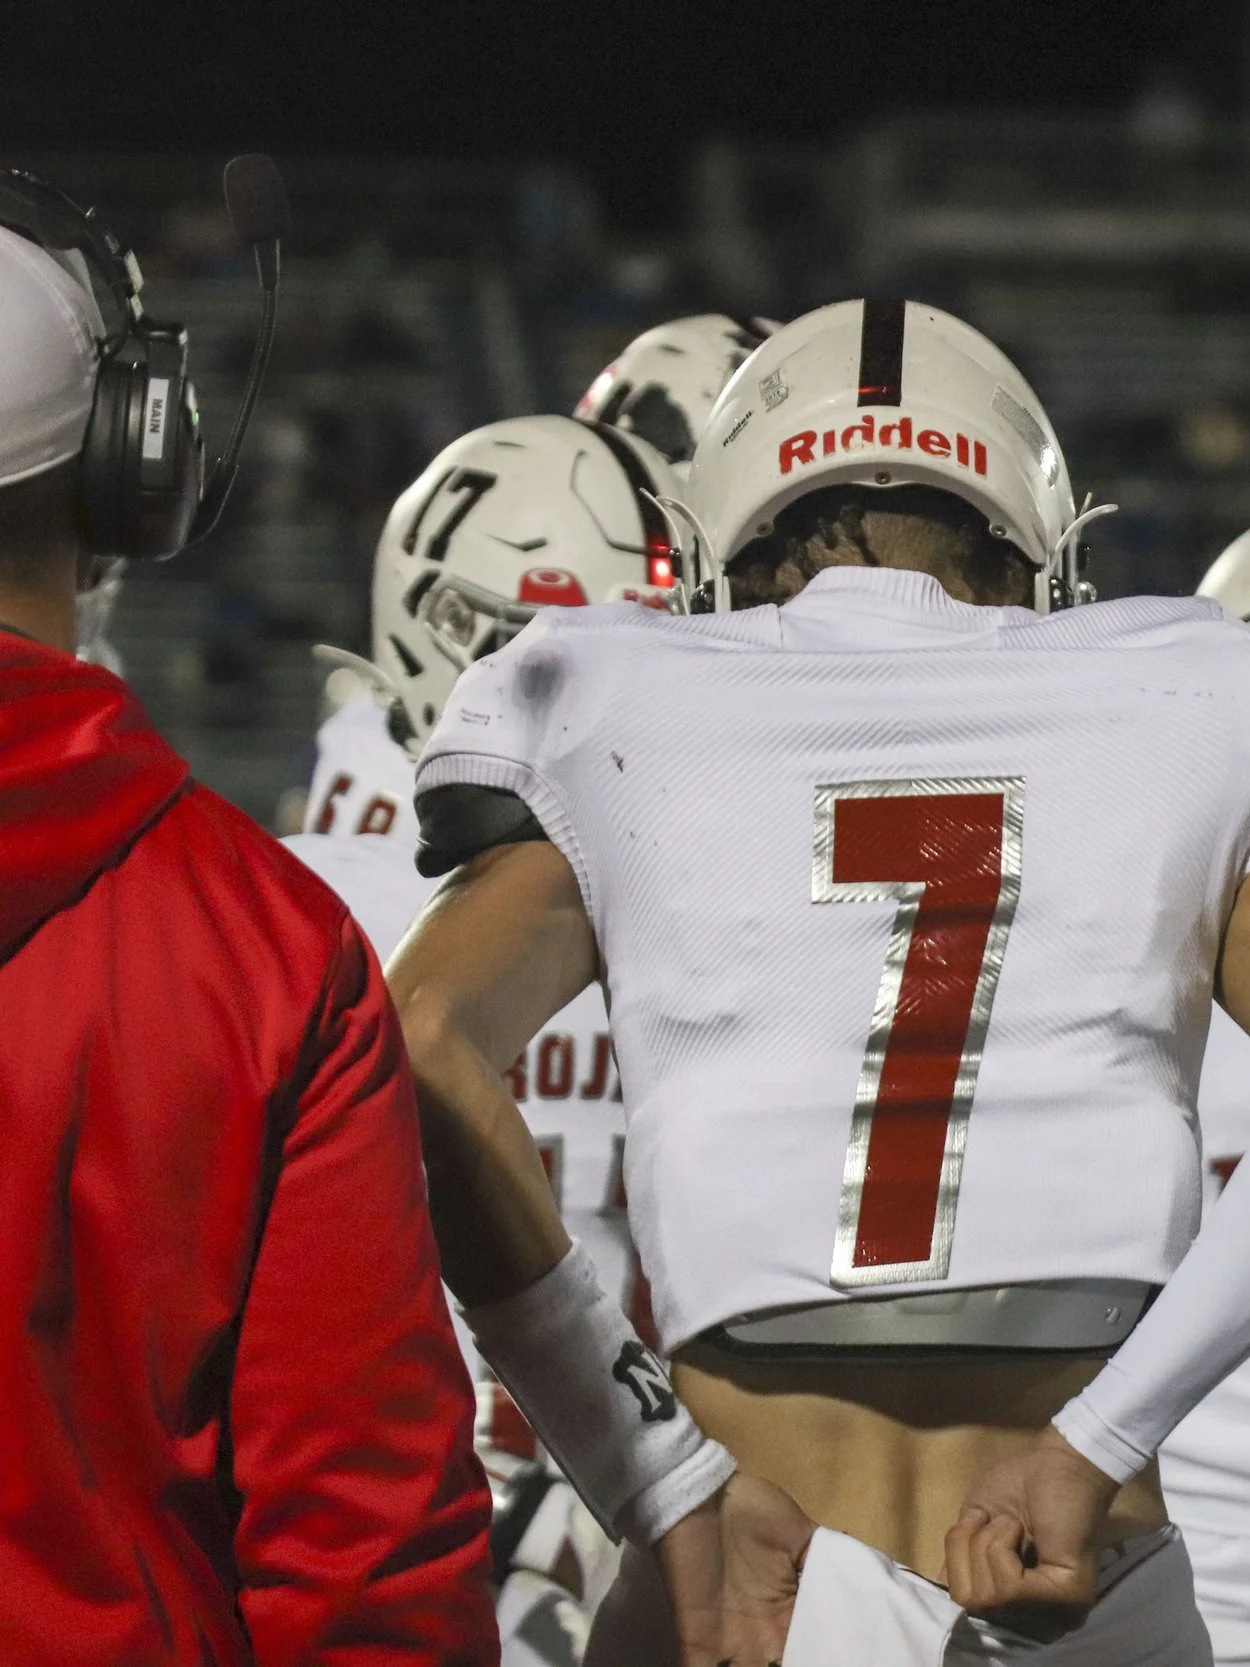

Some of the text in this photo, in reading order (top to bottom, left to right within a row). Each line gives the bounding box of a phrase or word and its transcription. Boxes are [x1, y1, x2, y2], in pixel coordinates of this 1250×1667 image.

[150, 398, 163, 433] MAIN
[778, 414, 988, 476] Riddell
[812, 777, 1025, 1288] 7
